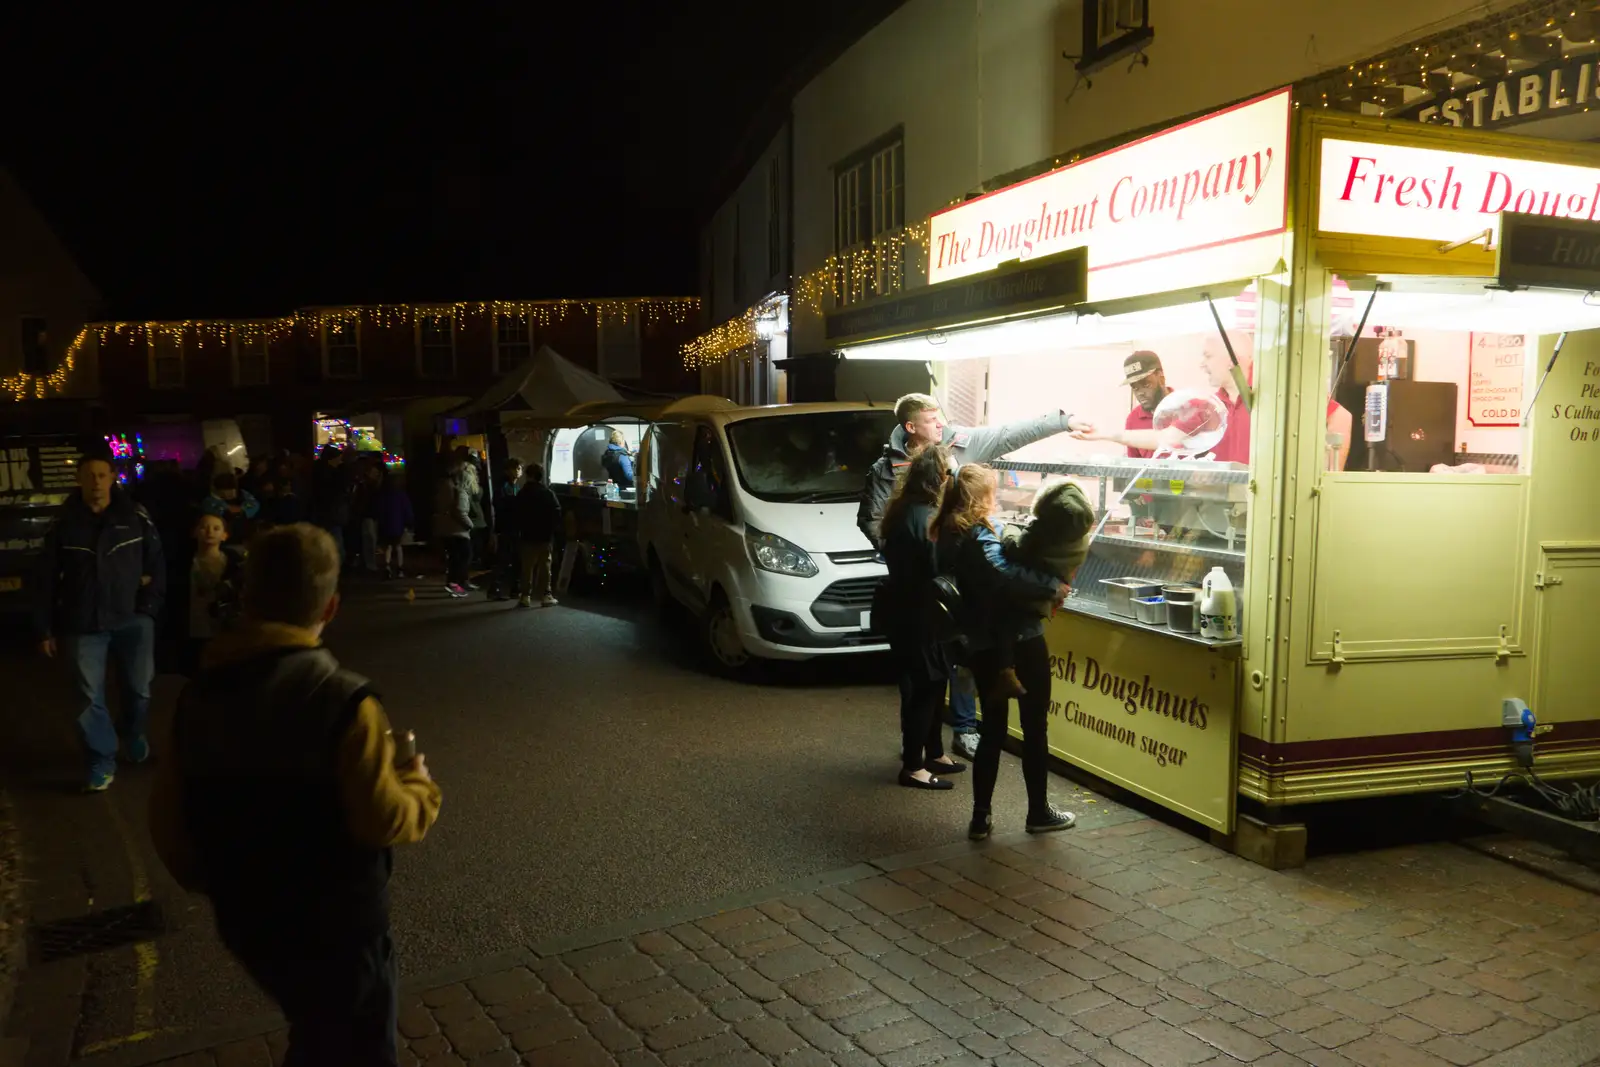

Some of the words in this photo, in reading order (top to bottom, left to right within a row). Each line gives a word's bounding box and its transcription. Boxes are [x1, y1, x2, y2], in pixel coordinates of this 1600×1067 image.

[1419, 64, 1600, 127] STABLI
[937, 230, 971, 269] The
[977, 194, 1099, 258] Doughnut
[1109, 147, 1274, 222] Company
[1338, 155, 1463, 211] Fresh
[1481, 409, 1508, 418] COLD
[1570, 427, 1588, 441] On
[1082, 656, 1210, 730] Doughnuts
[1064, 700, 1136, 748] Cinnamon
[1140, 734, 1188, 768] sugar
